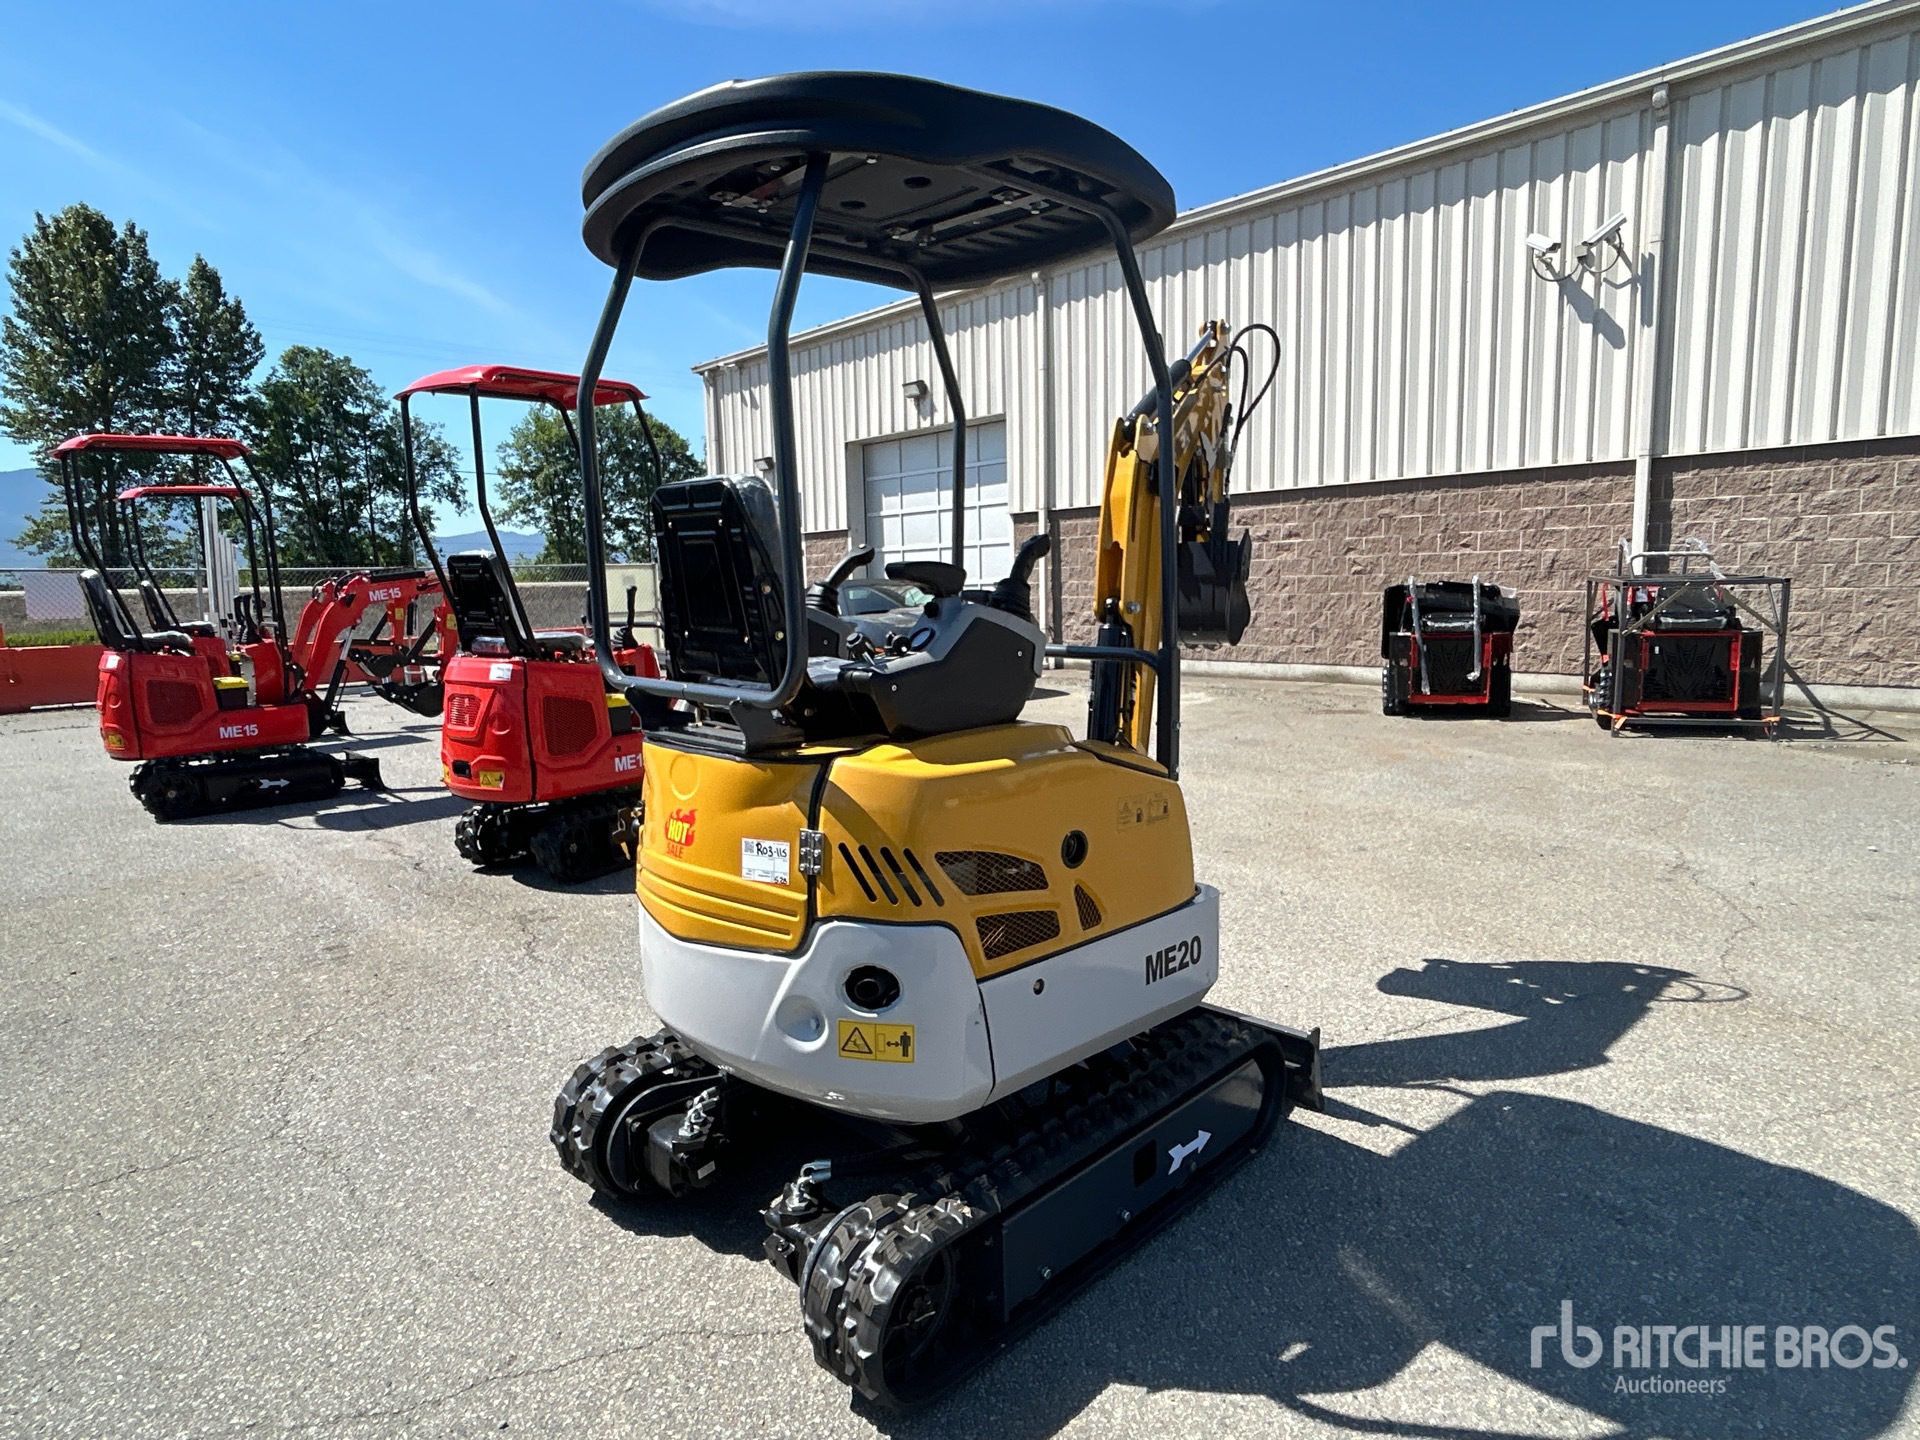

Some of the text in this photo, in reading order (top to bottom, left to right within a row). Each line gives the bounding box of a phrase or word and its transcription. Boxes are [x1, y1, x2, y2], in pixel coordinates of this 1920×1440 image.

[368, 588, 402, 602] ME15
[219, 724, 259, 739] ME15
[614, 752, 643, 773] ME1
[667, 818, 690, 844] HOT
[1145, 935, 1202, 986] ME20
